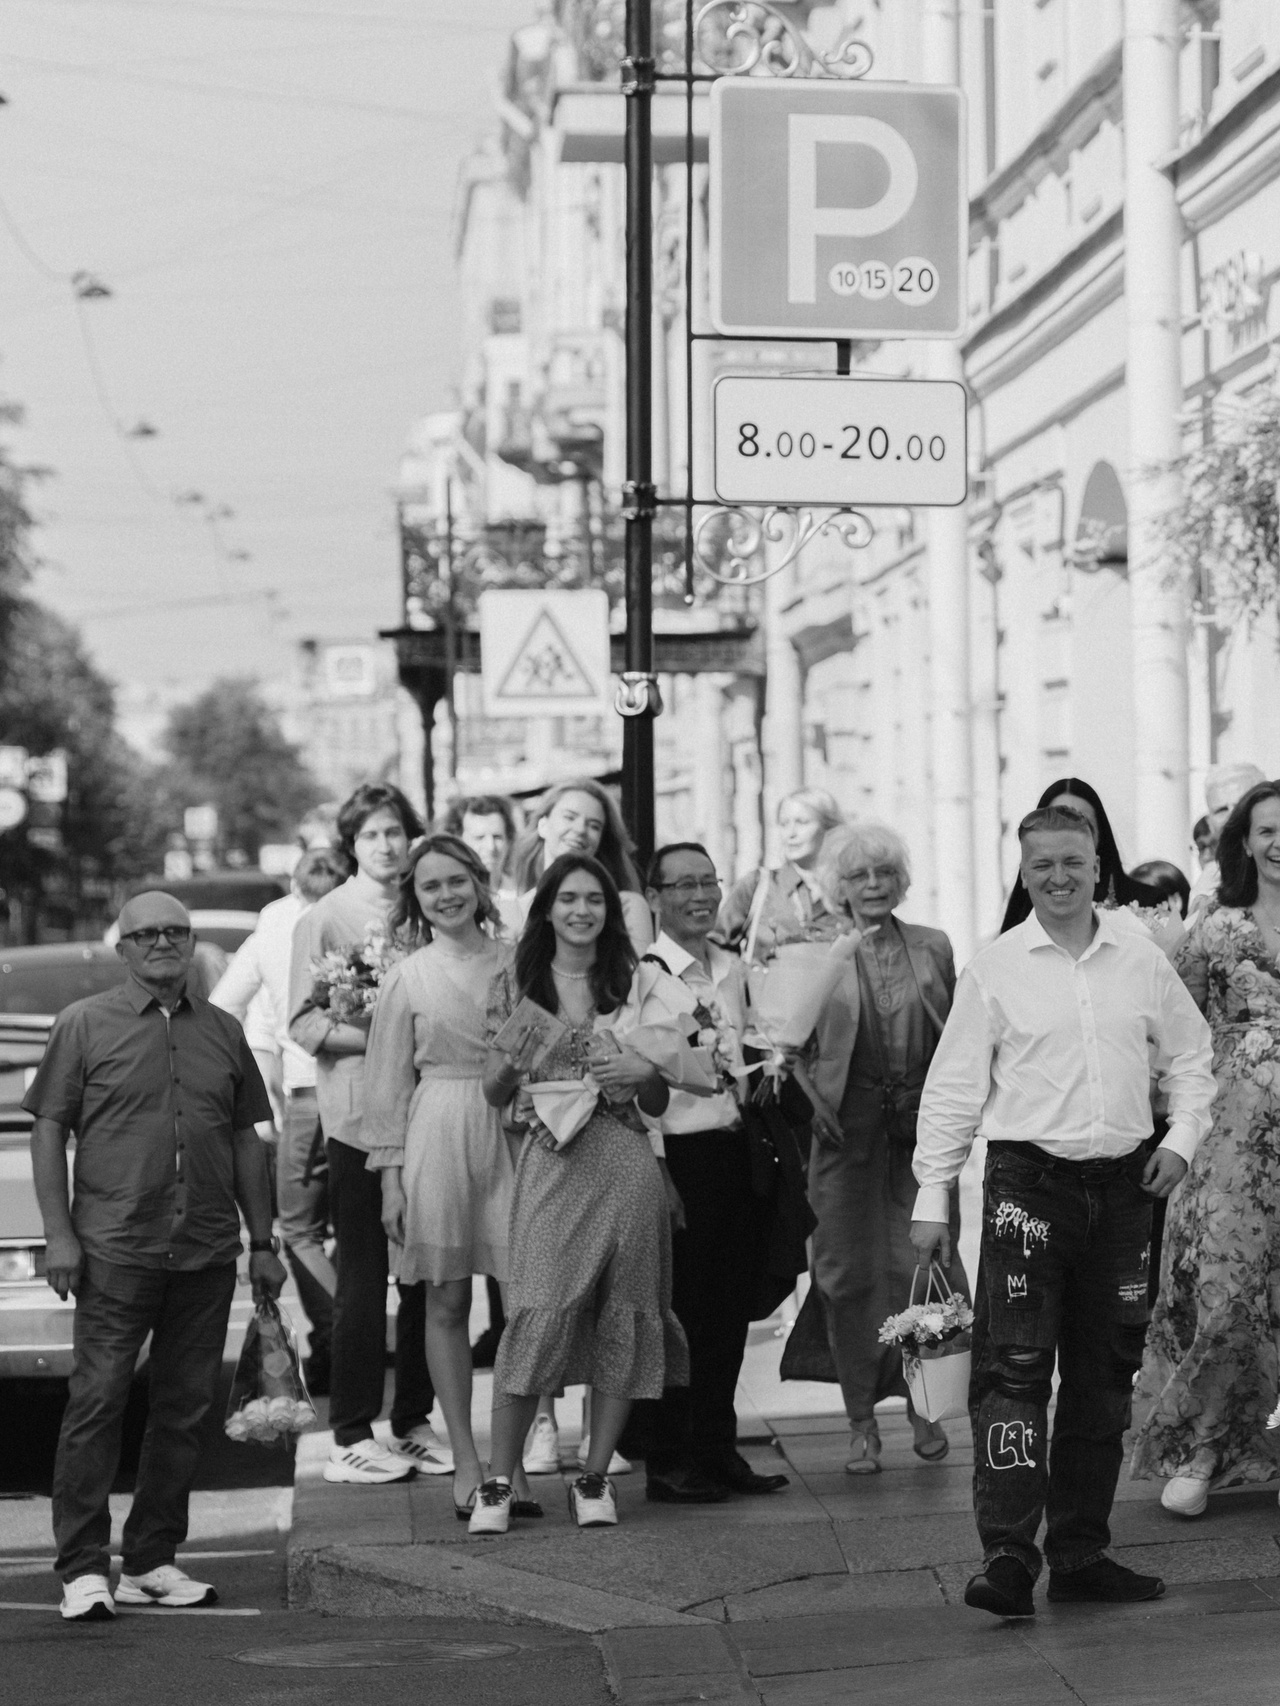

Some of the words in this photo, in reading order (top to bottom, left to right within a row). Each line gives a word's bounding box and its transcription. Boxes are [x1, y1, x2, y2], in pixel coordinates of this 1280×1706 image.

[788, 113, 918, 304] P
[837, 270, 856, 287] 10
[865, 269, 886, 289] 15
[898, 266, 934, 293] 20
[738, 422, 946, 462] 8.00-20.00
